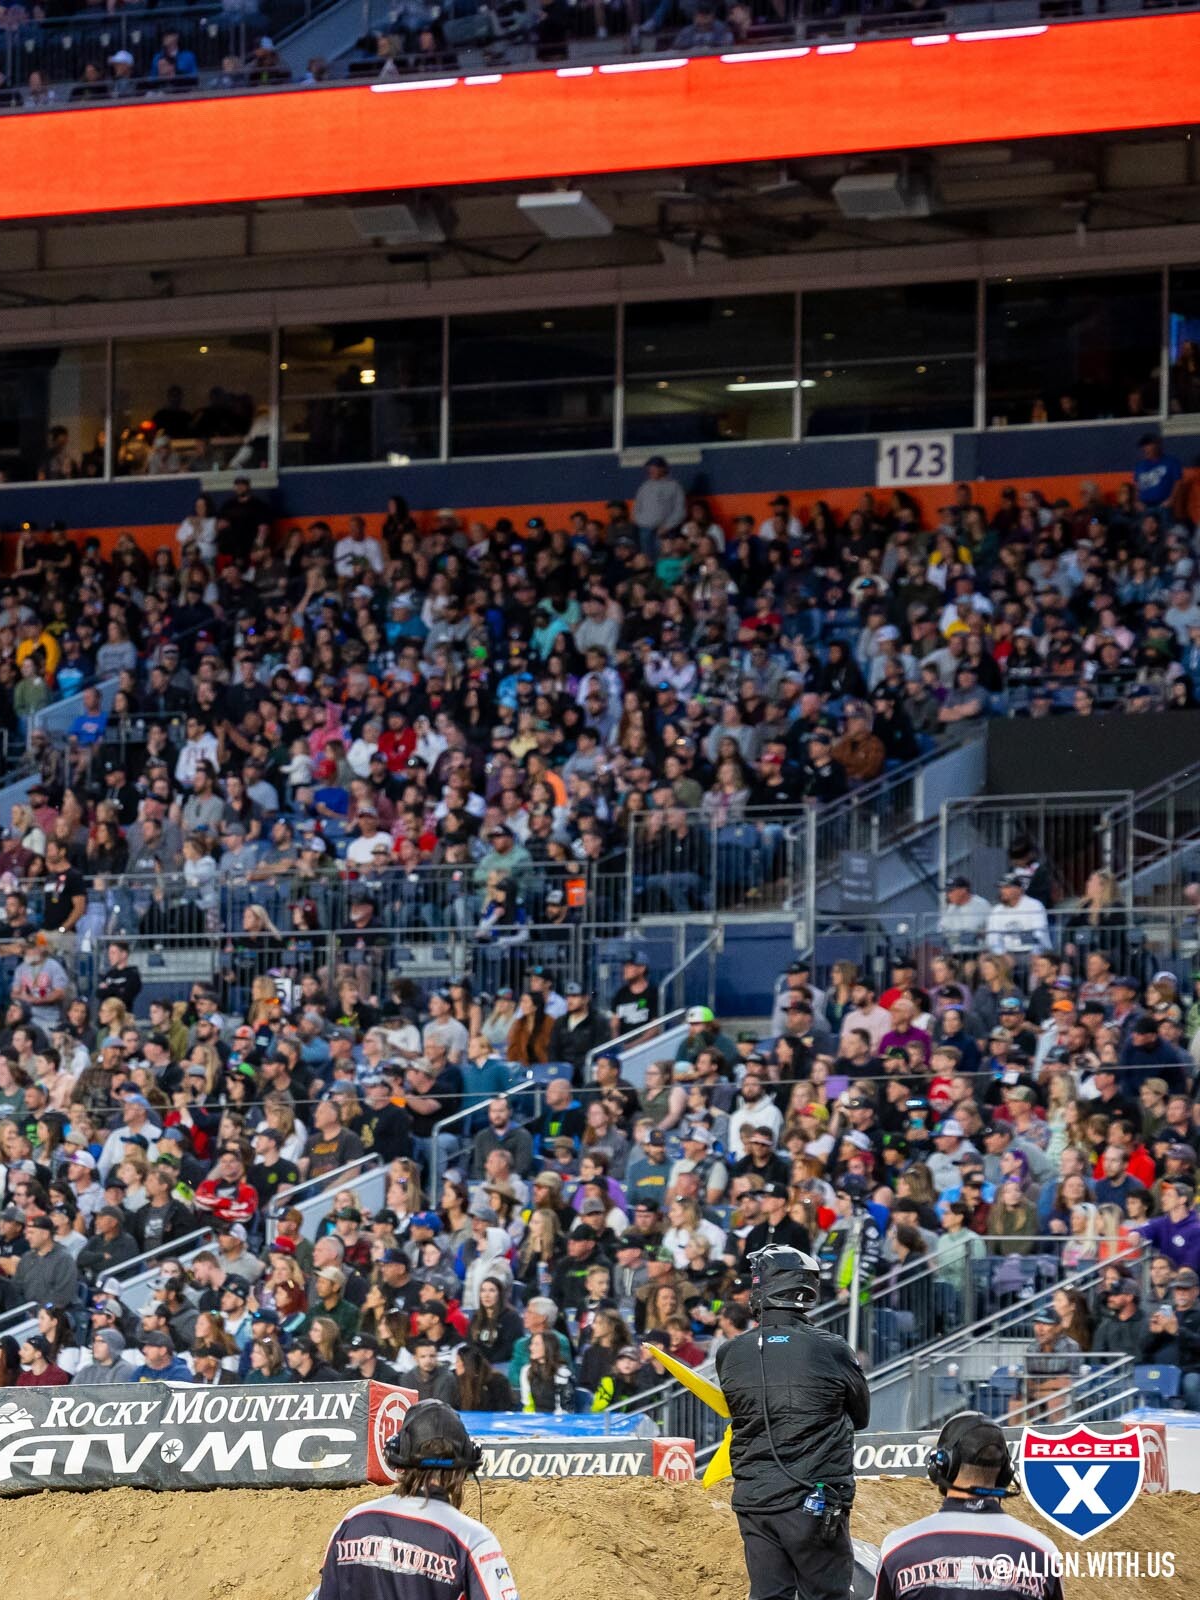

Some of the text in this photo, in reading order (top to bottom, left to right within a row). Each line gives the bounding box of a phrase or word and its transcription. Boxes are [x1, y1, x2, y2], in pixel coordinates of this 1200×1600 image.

[886, 443, 946, 479] 123
[40, 1391, 362, 1428] ROCKY MOUNTAIN
[478, 1449, 646, 1478] MOUNTAIN
[853, 1444, 933, 1470] OCKY
[336, 1539, 381, 1562] DIRT
[897, 1560, 961, 1591] DIRT
